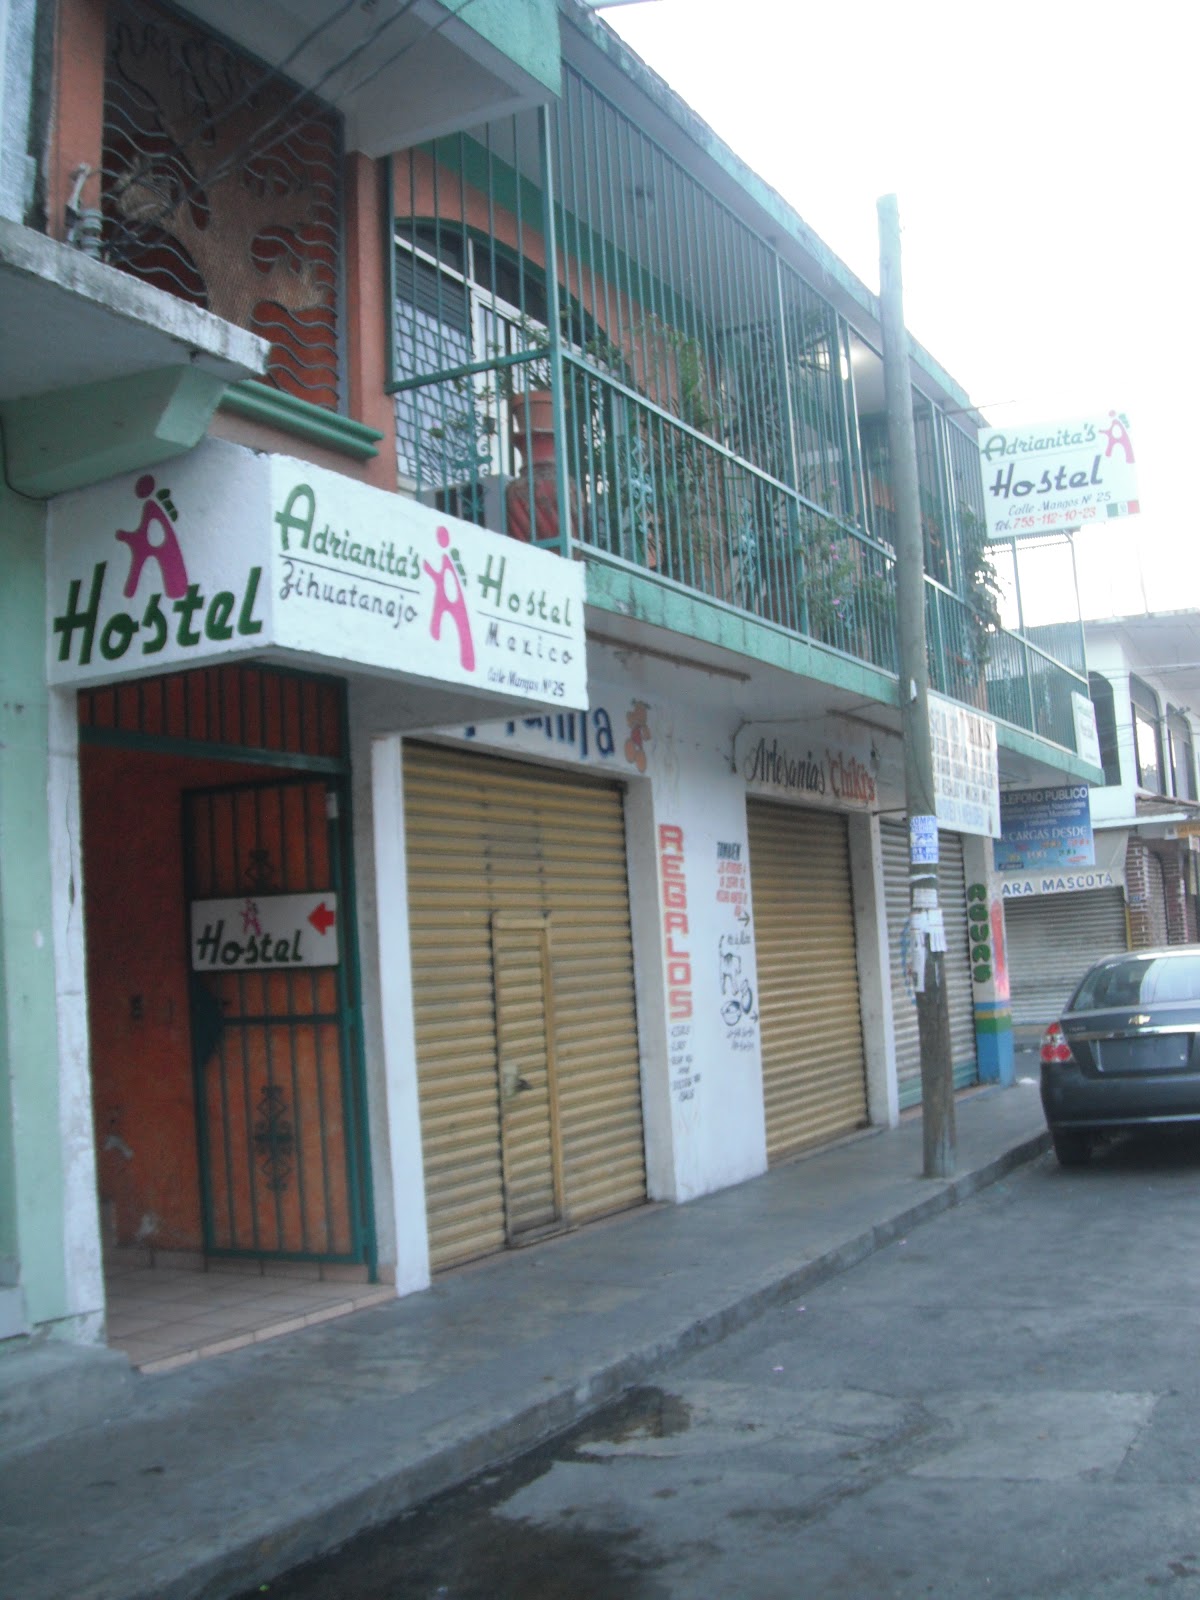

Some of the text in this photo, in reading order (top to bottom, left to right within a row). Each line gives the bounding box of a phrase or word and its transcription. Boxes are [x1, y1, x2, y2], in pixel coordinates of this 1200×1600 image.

[981, 423, 1096, 462] Adrianita's
[989, 454, 1103, 499] Hostel
[275, 483, 420, 580] Adrianita's
[1008, 503, 1034, 517] Calle
[1096, 491, 1111, 503] 25
[53, 561, 263, 666] Hostel
[279, 560, 418, 629] Zihuatanejo
[477, 554, 572, 627] Hostel
[197, 920, 302, 965] Hostel
[659, 823, 693, 1022] REGALOS
